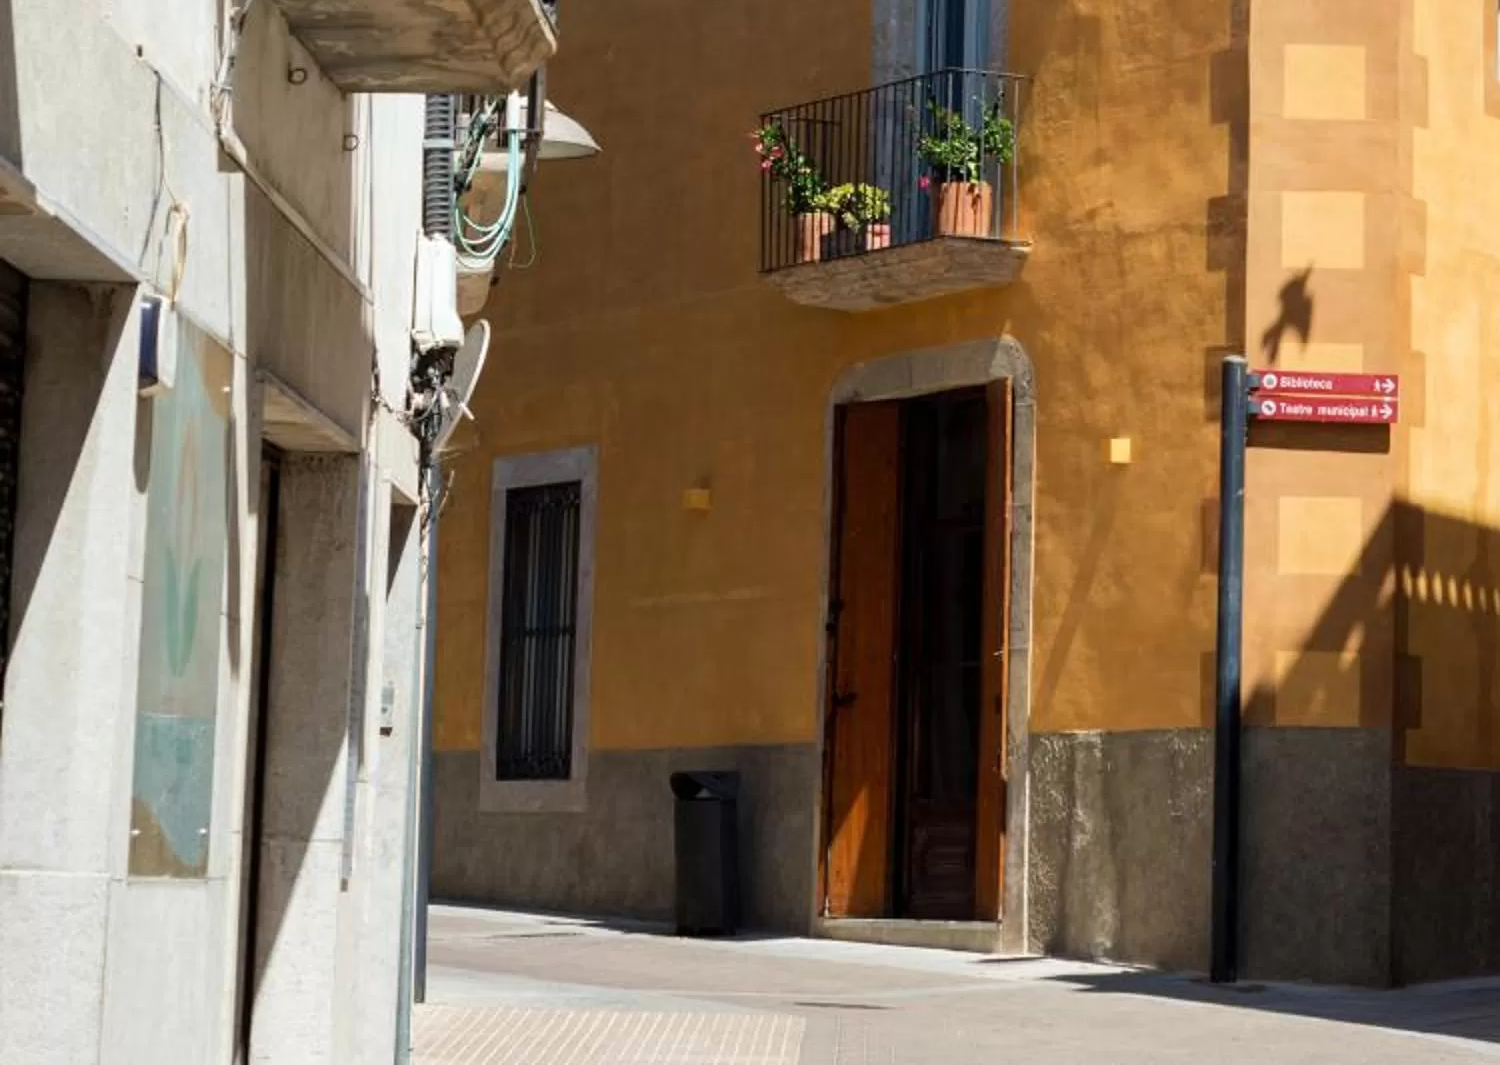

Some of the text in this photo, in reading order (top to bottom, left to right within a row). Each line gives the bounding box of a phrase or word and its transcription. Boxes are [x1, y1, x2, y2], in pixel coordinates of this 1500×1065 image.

[1279, 375, 1333, 390] Biblioteca
[1280, 402, 1369, 419] Teatre municipal
